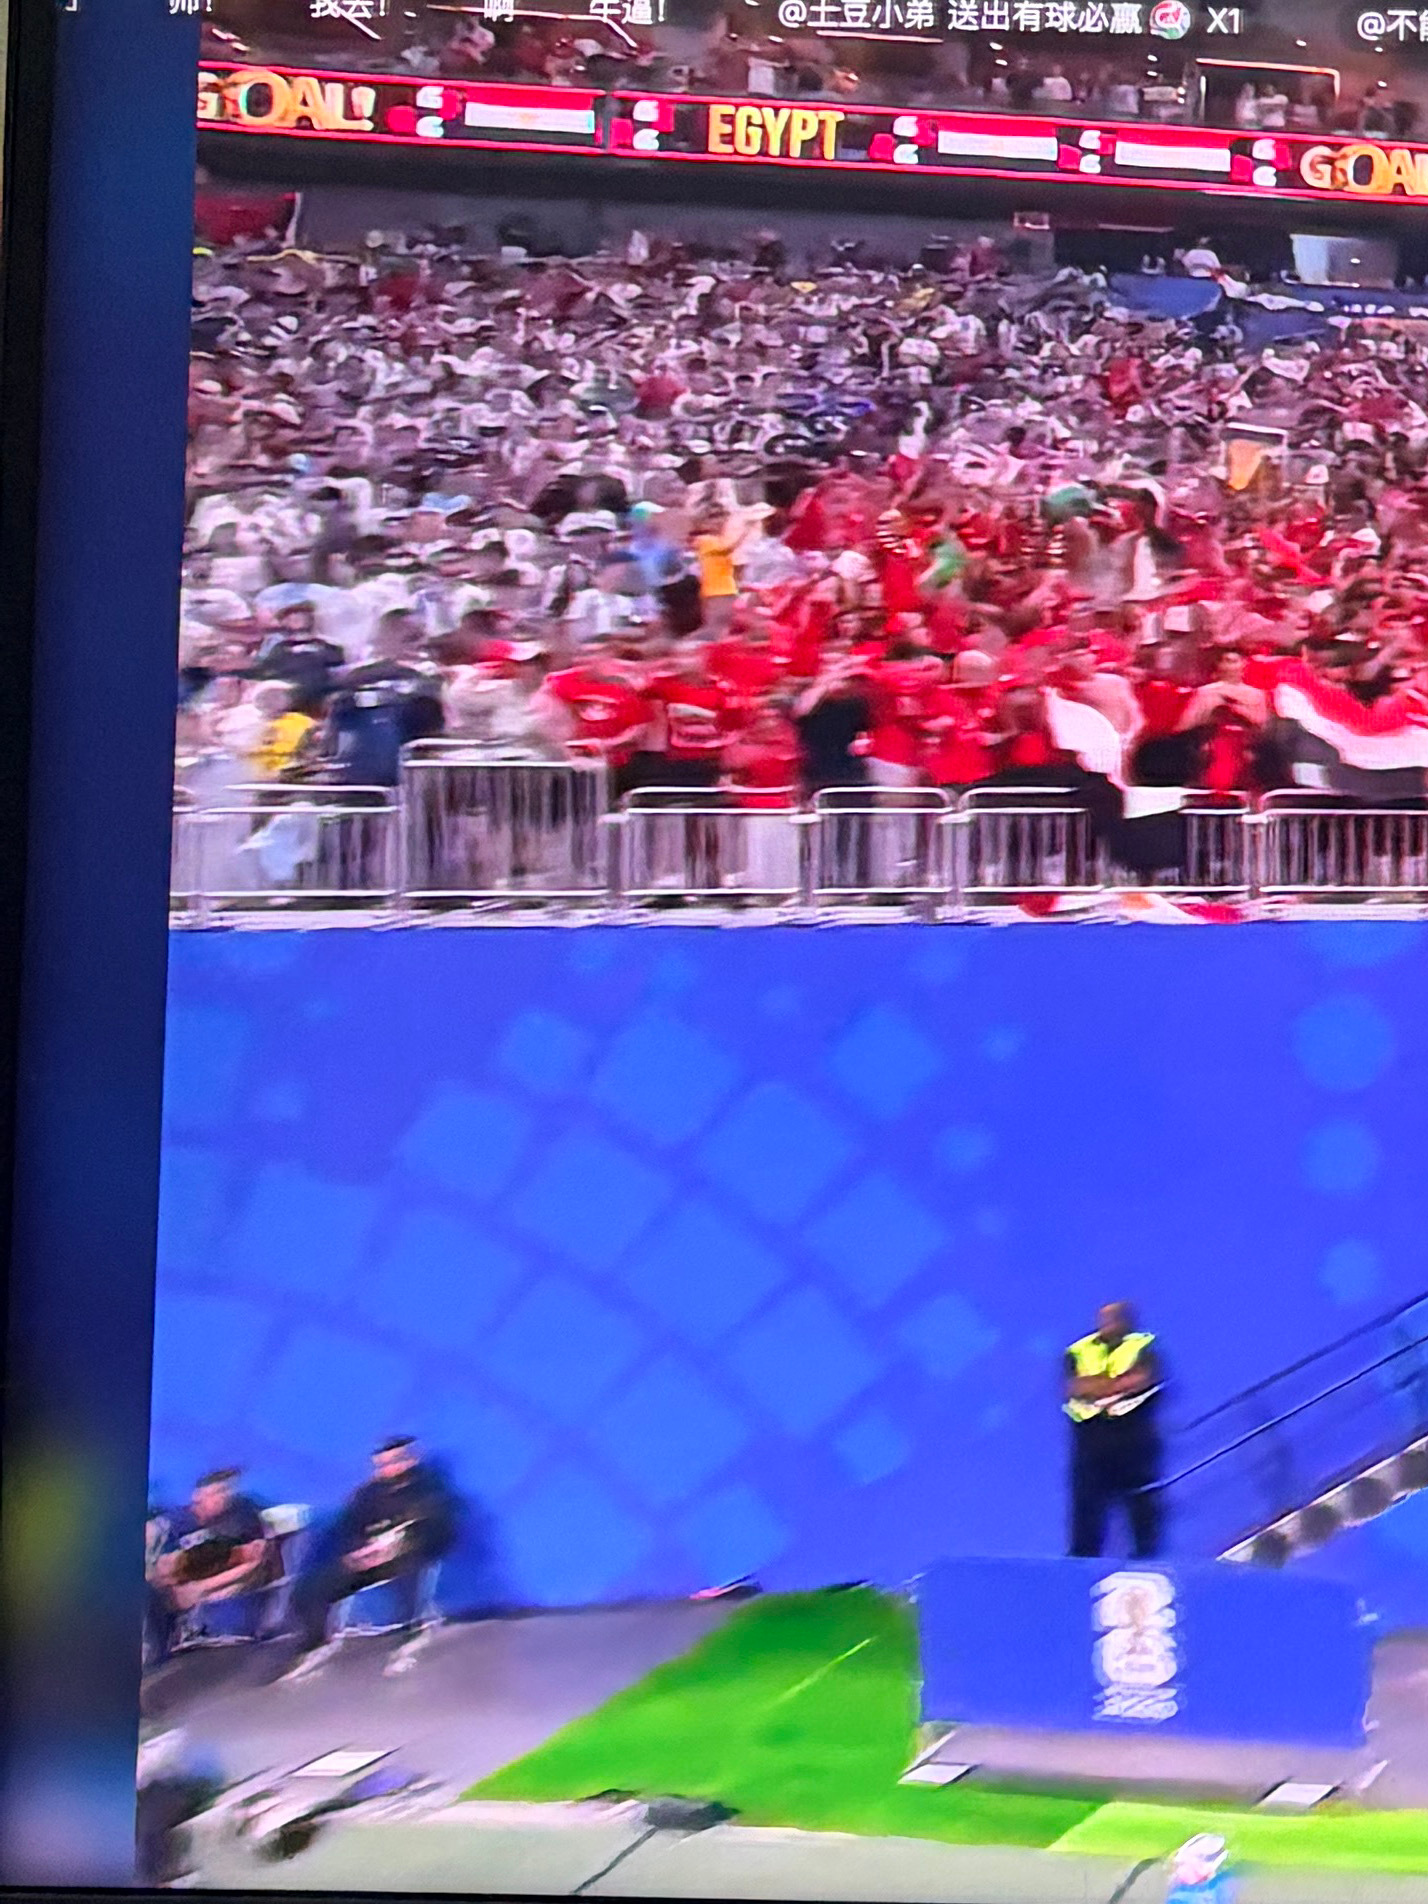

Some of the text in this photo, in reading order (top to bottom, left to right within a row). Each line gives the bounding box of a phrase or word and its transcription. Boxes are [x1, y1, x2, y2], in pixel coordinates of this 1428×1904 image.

[947, 0, 1143, 35] 送出有球必赢
[1206, 6, 1244, 35] X1
[707, 105, 844, 160] EGYPT
